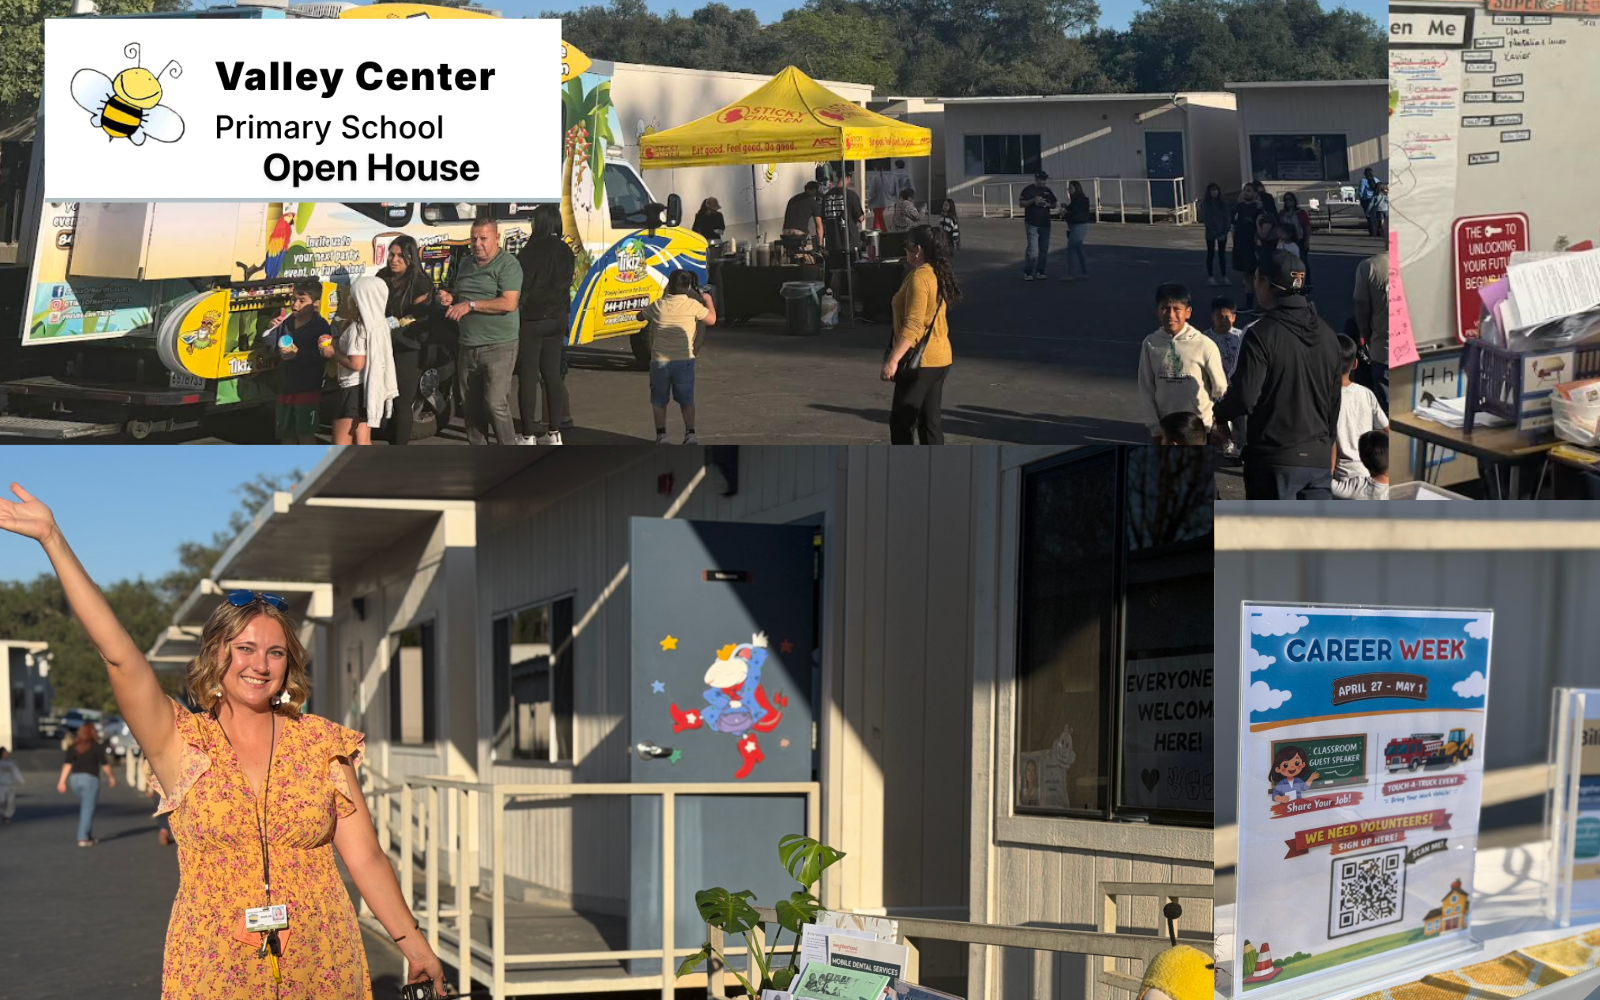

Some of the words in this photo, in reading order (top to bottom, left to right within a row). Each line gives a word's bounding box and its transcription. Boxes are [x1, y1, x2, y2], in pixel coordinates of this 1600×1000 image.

[1494, 0, 1543, 10] SUPER
[1563, 0, 1590, 11] BEE
[1428, 20, 1456, 36] Me
[1505, 27, 1531, 35] Claire
[1509, 38, 1541, 48] Natalia
[1504, 52, 1531, 61] Xavier
[744, 115, 804, 124] CHICKEN
[751, 106, 807, 118] STICKY
[692, 146, 703, 155] Eat
[704, 147, 724, 155] good.
[726, 143, 741, 153] Feel
[742, 144, 764, 154] good.
[765, 143, 774, 152] Do
[775, 142, 798, 152] good.
[1465, 226, 1482, 239] THE
[1505, 223, 1516, 235] TO
[306, 236, 330, 247] Invite
[331, 236, 342, 247] us
[342, 236, 351, 246] to
[419, 234, 449, 248] Menu
[1469, 240, 1517, 255] UNLOCKING
[294, 253, 314, 264] your
[315, 251, 334, 262] next
[618, 250, 641, 271] Tikiz
[1463, 258, 1487, 272] YOUR
[1488, 256, 1511, 269] FUTU
[310, 266, 320, 276] or
[228, 357, 252, 374] Tikiz
[1422, 367, 1435, 386] H
[1443, 366, 1453, 382] h
[1285, 638, 1393, 662] CAREER
[1399, 638, 1466, 661] WEEK
[1127, 668, 1213, 693] EVERYONE
[1338, 683, 1367, 697] APRIL
[1371, 681, 1383, 692] 27
[1395, 681, 1416, 692] MAY
[1418, 684, 1423, 693] 1
[1138, 700, 1214, 721] WELCOM
[1154, 731, 1202, 752] HERE!
[1313, 743, 1358, 755] CLASSROOM
[1309, 756, 1330, 767] GUEST
[1332, 754, 1361, 764] SPEAKER
[1387, 778, 1440, 793] TOUCH-A-TRUCK
[1440, 777, 1458, 786] EVENT
[1286, 801, 1312, 813] Share
[1314, 798, 1332, 808] Your
[1334, 794, 1352, 805] Job!
[1406, 794, 1418, 802] Your
[1305, 831, 1325, 845] WE
[1328, 824, 1358, 839] NEED
[1361, 813, 1433, 833] VOLUNTEERS!
[1338, 840, 1359, 851] SIGN
[1361, 838, 1372, 847] UP
[1374, 833, 1398, 844] HERE!
[1412, 846, 1430, 860] SCAN
[1431, 841, 1444, 850] ME!
[832, 957, 852, 968] MOBILE
[852, 960, 873, 972] DENTAL
[872, 965, 899, 976] SERVICES
